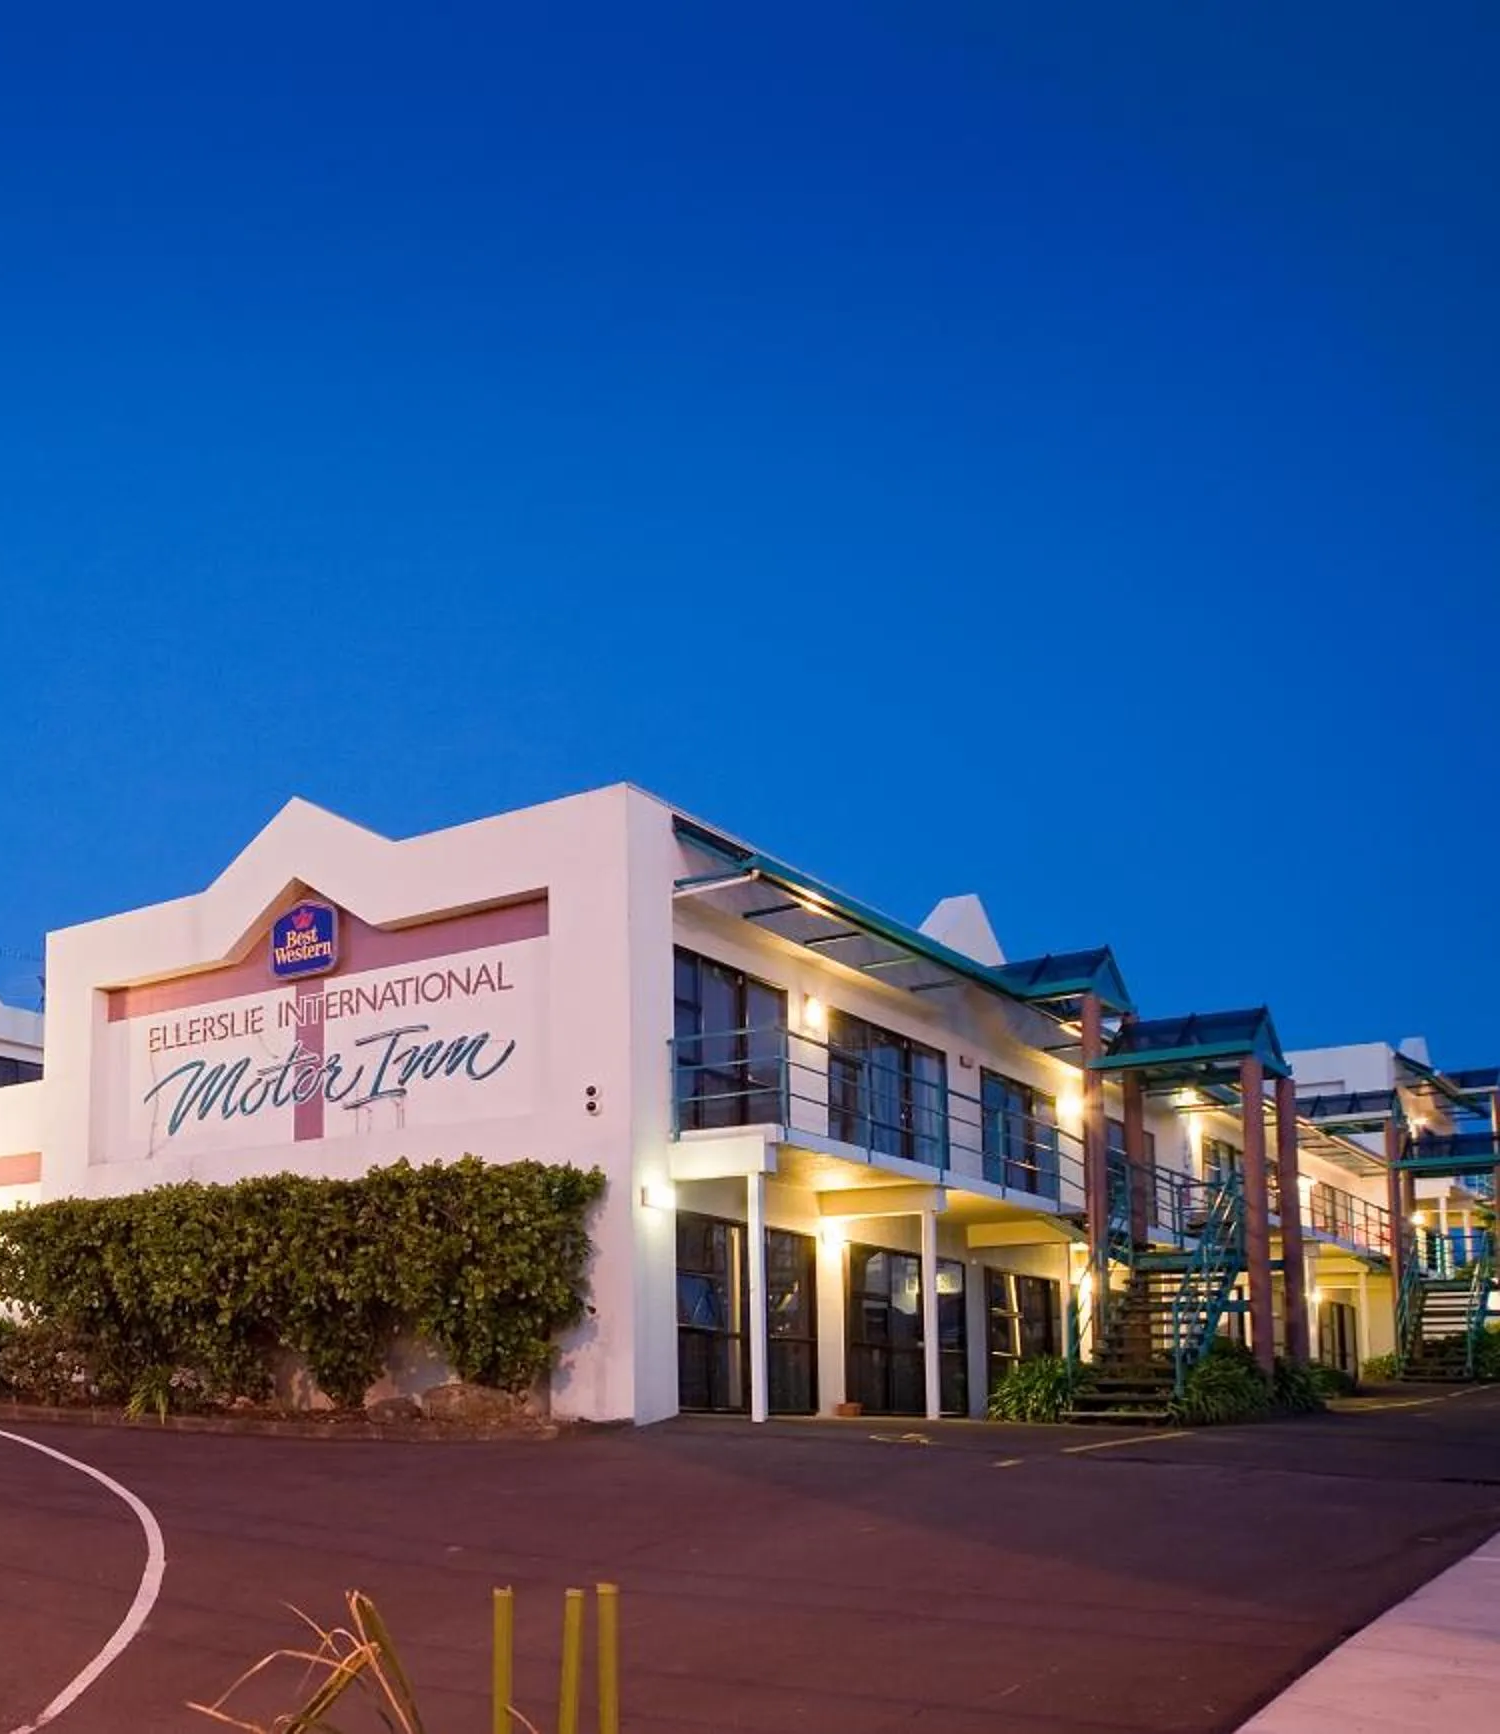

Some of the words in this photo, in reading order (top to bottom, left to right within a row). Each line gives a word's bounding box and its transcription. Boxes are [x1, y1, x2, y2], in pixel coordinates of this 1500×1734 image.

[275, 941, 331, 965] Western
[286, 926, 318, 949] Best
[149, 1005, 265, 1053] ELLERSLIE
[278, 961, 513, 1028] INTERNATIONAL
[144, 1040, 364, 1137] Motor
[344, 1024, 516, 1110] Inn
